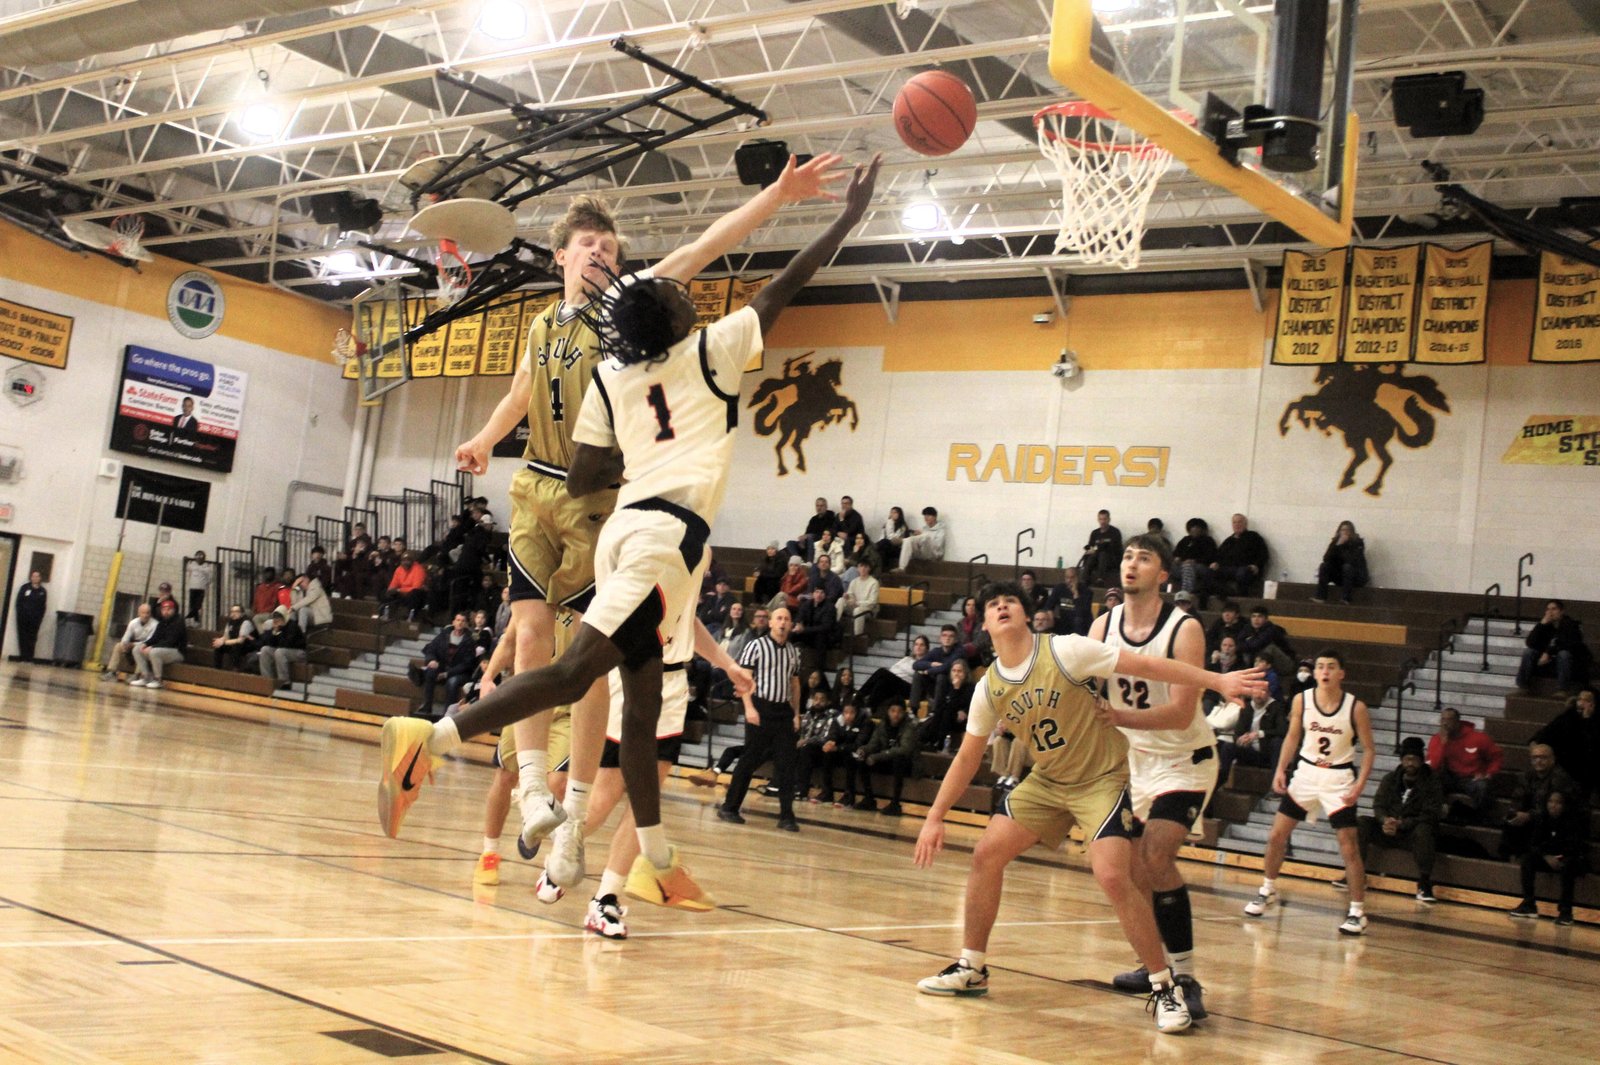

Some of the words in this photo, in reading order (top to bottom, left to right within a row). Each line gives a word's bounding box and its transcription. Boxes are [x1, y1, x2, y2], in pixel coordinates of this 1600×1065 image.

[1372, 256, 1398, 270] BOYS
[1354, 273, 1411, 288] BASKETBALL
[1288, 296, 1332, 313] DISTRICT
[1357, 293, 1404, 310] DISTRICT
[1430, 297, 1477, 310] DISTRICT
[1545, 290, 1597, 307] DISTRICT
[1282, 318, 1335, 335] CHAMPIONS
[1351, 317, 1407, 334] CHAMPIONS
[1423, 319, 1480, 333] CHAMPIONS
[1292, 342, 1320, 355] 2012
[1355, 340, 1398, 353] 2012-13
[131, 353, 143, 364] Go
[144, 358, 168, 371] where
[168, 362, 181, 374] the
[181, 367, 198, 378] pros
[646, 382, 676, 443] 1
[1522, 420, 1574, 438] HOME
[946, 442, 1171, 487] RAIDERS!
[1583, 449, 1600, 465] S
[1117, 677, 1152, 709] 22
[1006, 688, 1061, 724] SOUTH
[1031, 718, 1066, 752] 12
[1318, 737, 1331, 756] 2
